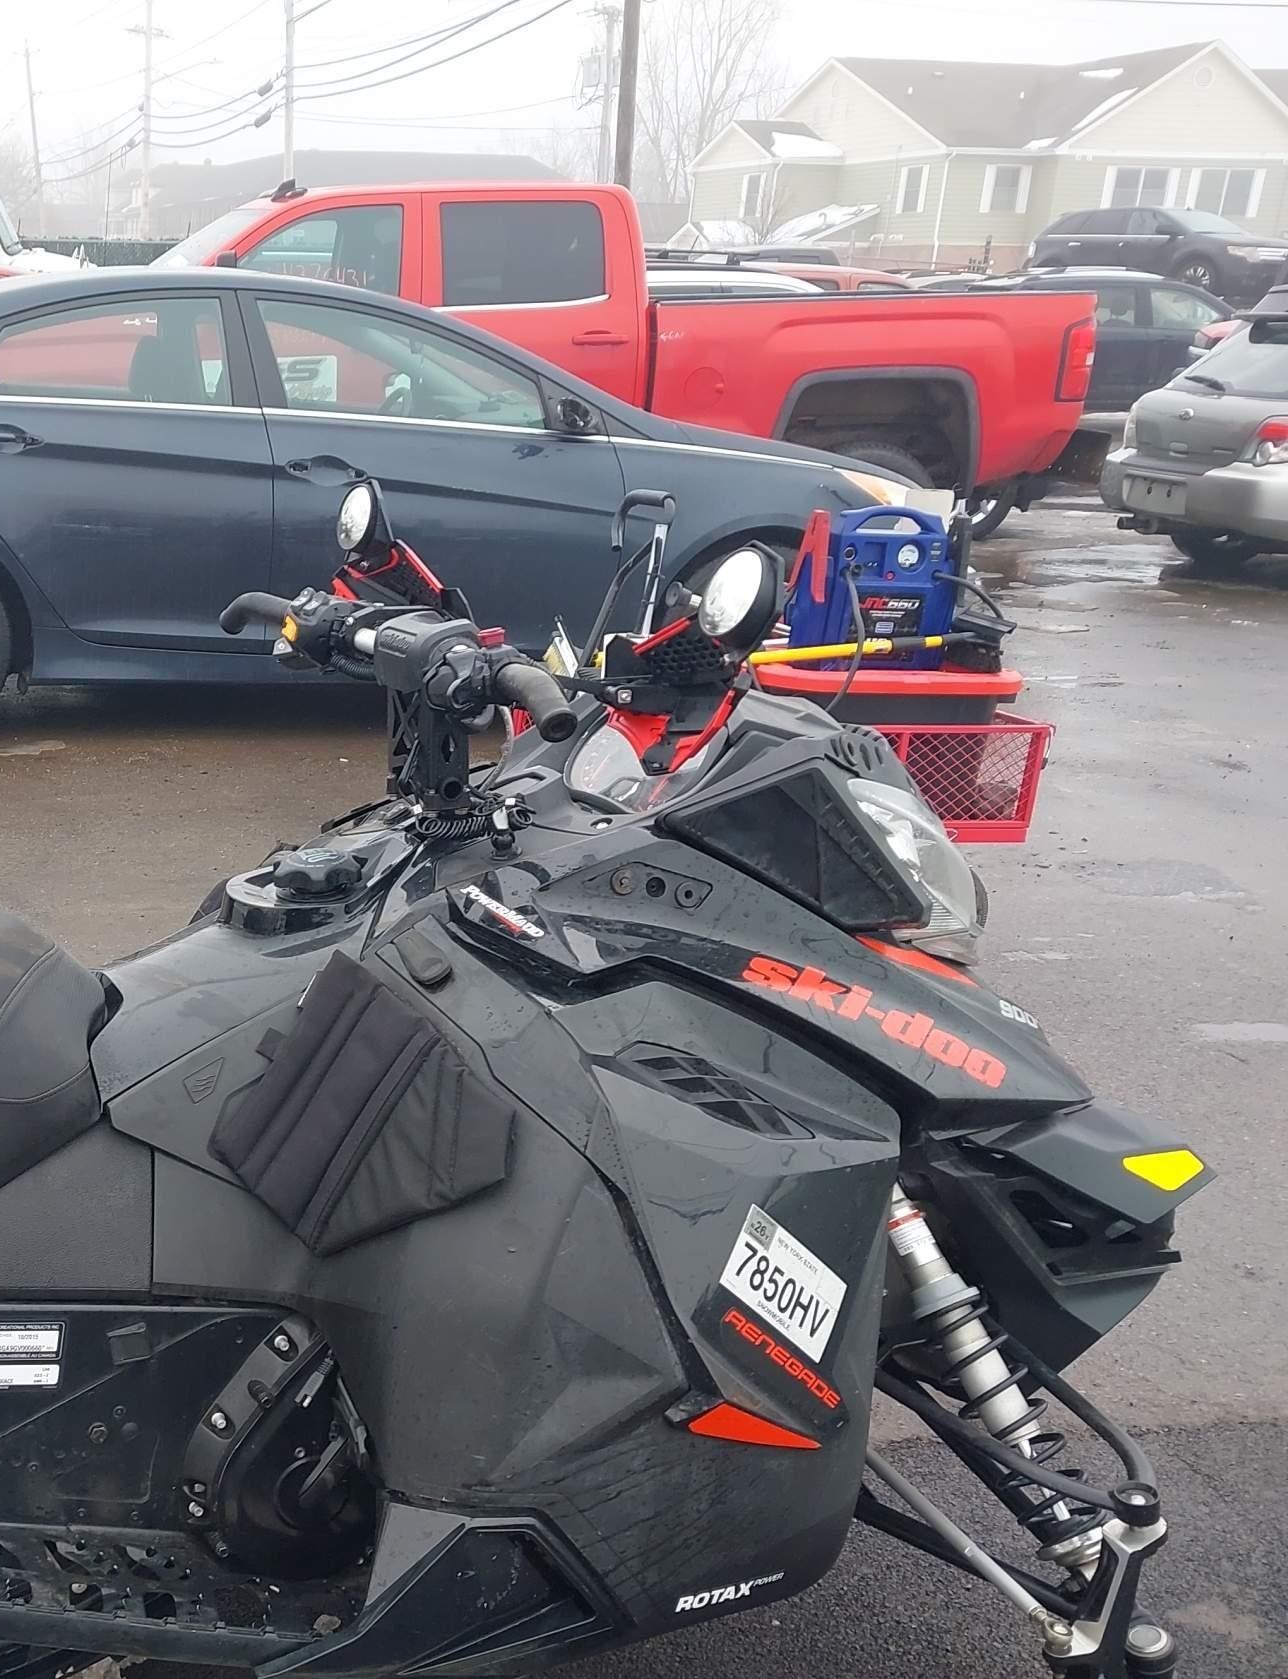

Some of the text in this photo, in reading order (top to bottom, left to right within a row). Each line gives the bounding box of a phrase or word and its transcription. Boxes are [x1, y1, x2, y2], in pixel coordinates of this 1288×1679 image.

[461, 884, 545, 938] POWERMADD
[999, 999, 1039, 1029] 900
[735, 1240, 830, 1338] 7850HV
[724, 1310, 841, 1409] RENEGADE
[674, 1571, 785, 1613] ROTAX POWER
